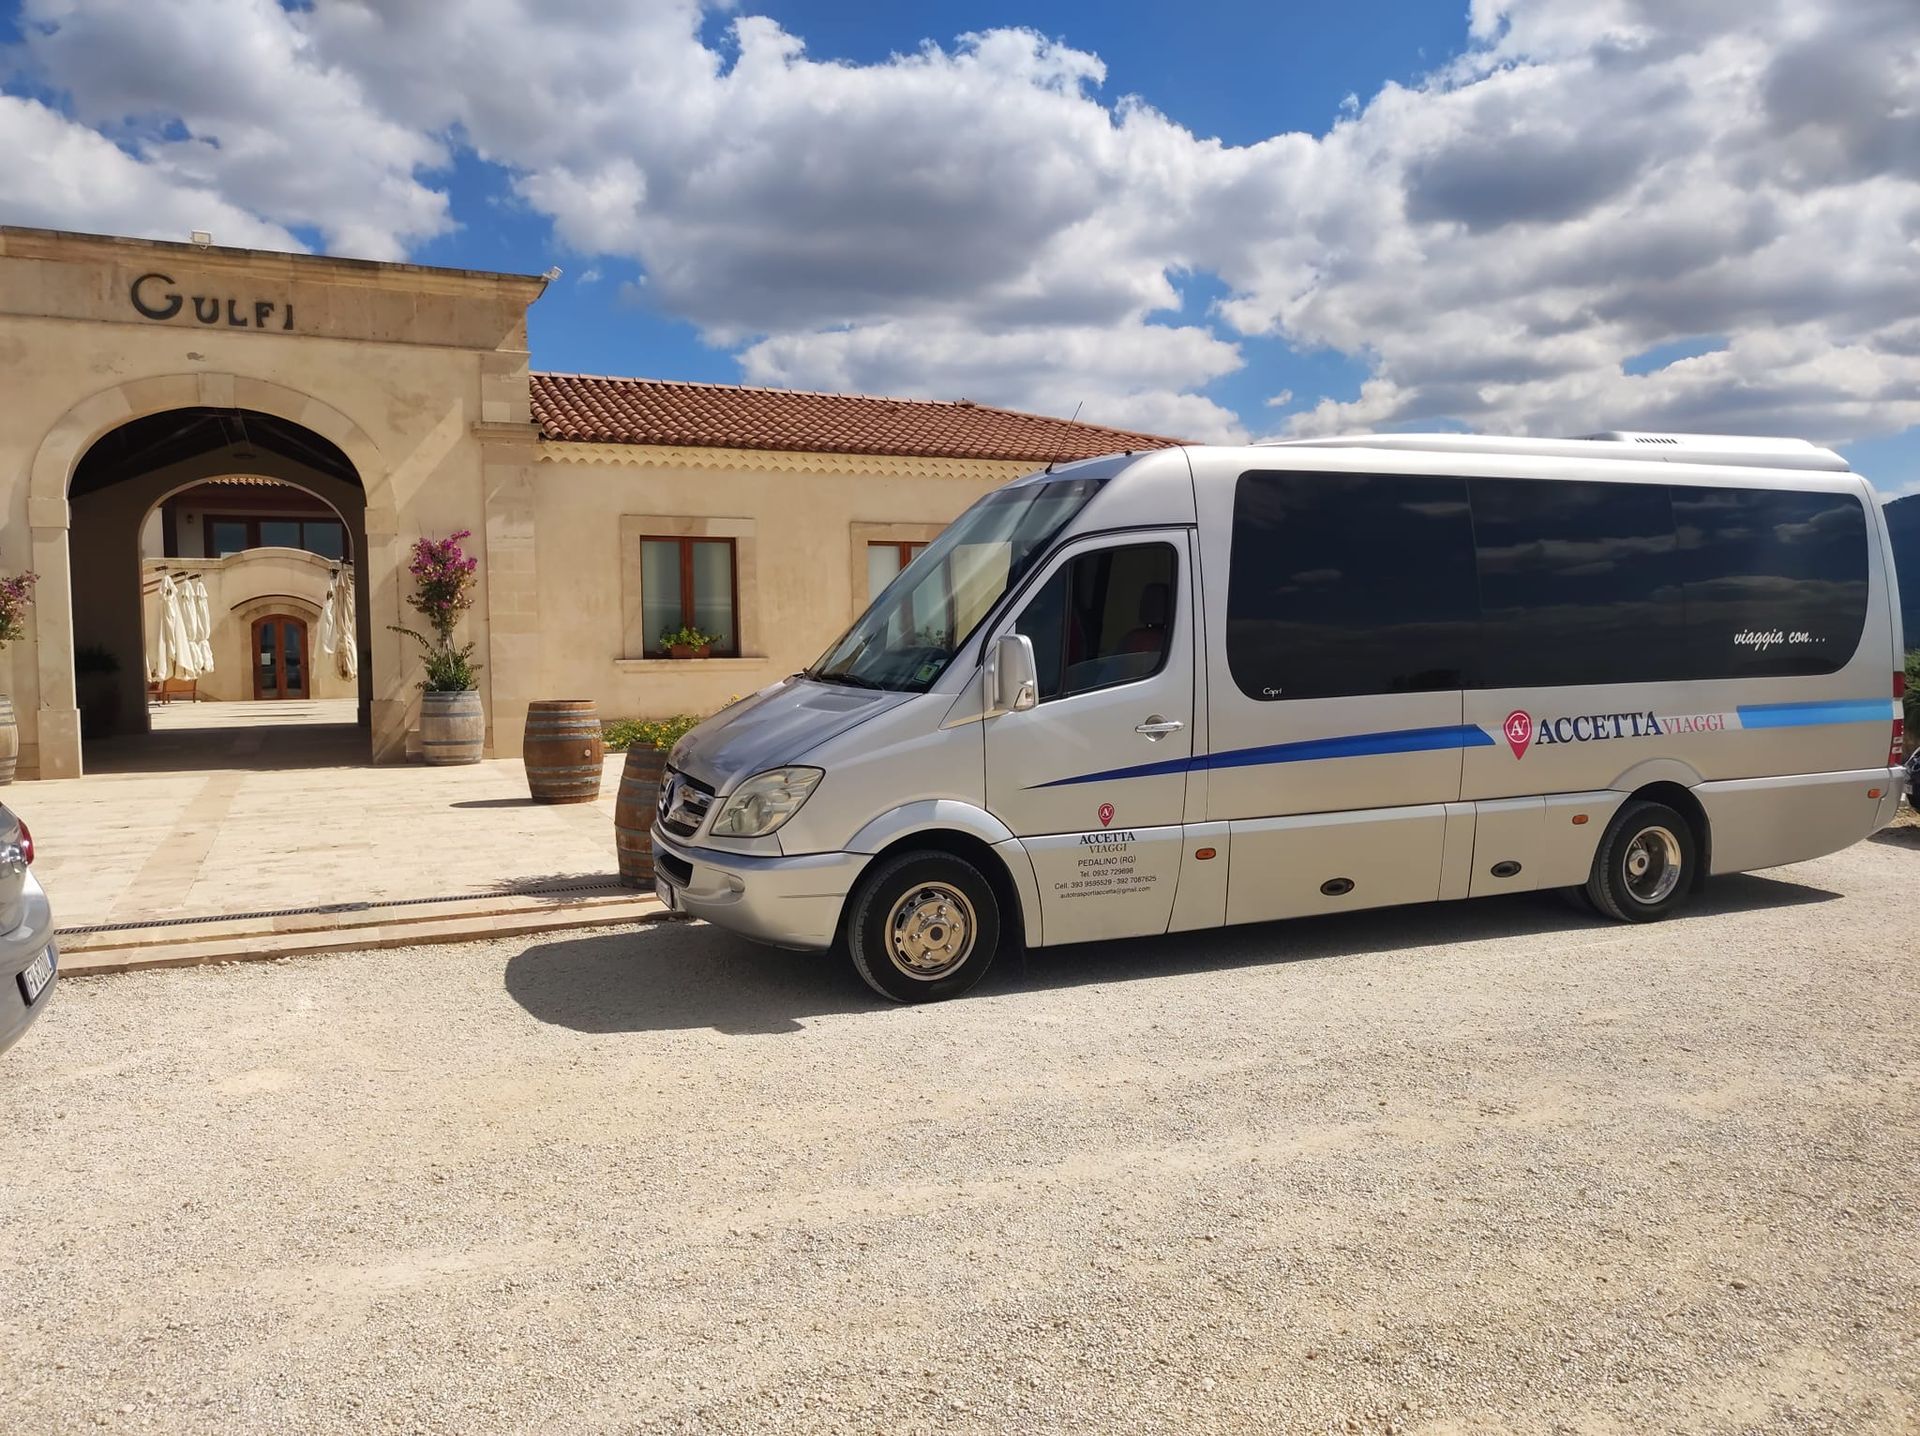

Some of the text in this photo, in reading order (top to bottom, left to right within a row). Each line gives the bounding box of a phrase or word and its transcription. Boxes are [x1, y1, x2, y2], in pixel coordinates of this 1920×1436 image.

[1734, 628, 1784, 651] viaggia
[1535, 711, 1725, 745] ACCETTA VIAGGI
[1079, 831, 1136, 845] ACCETTA
[1089, 843, 1127, 854] VIAGGI
[1077, 855, 1137, 867] PEDALINO (RG)
[1092, 868, 1109, 877] 0932
[1070, 881, 1083, 889] 393
